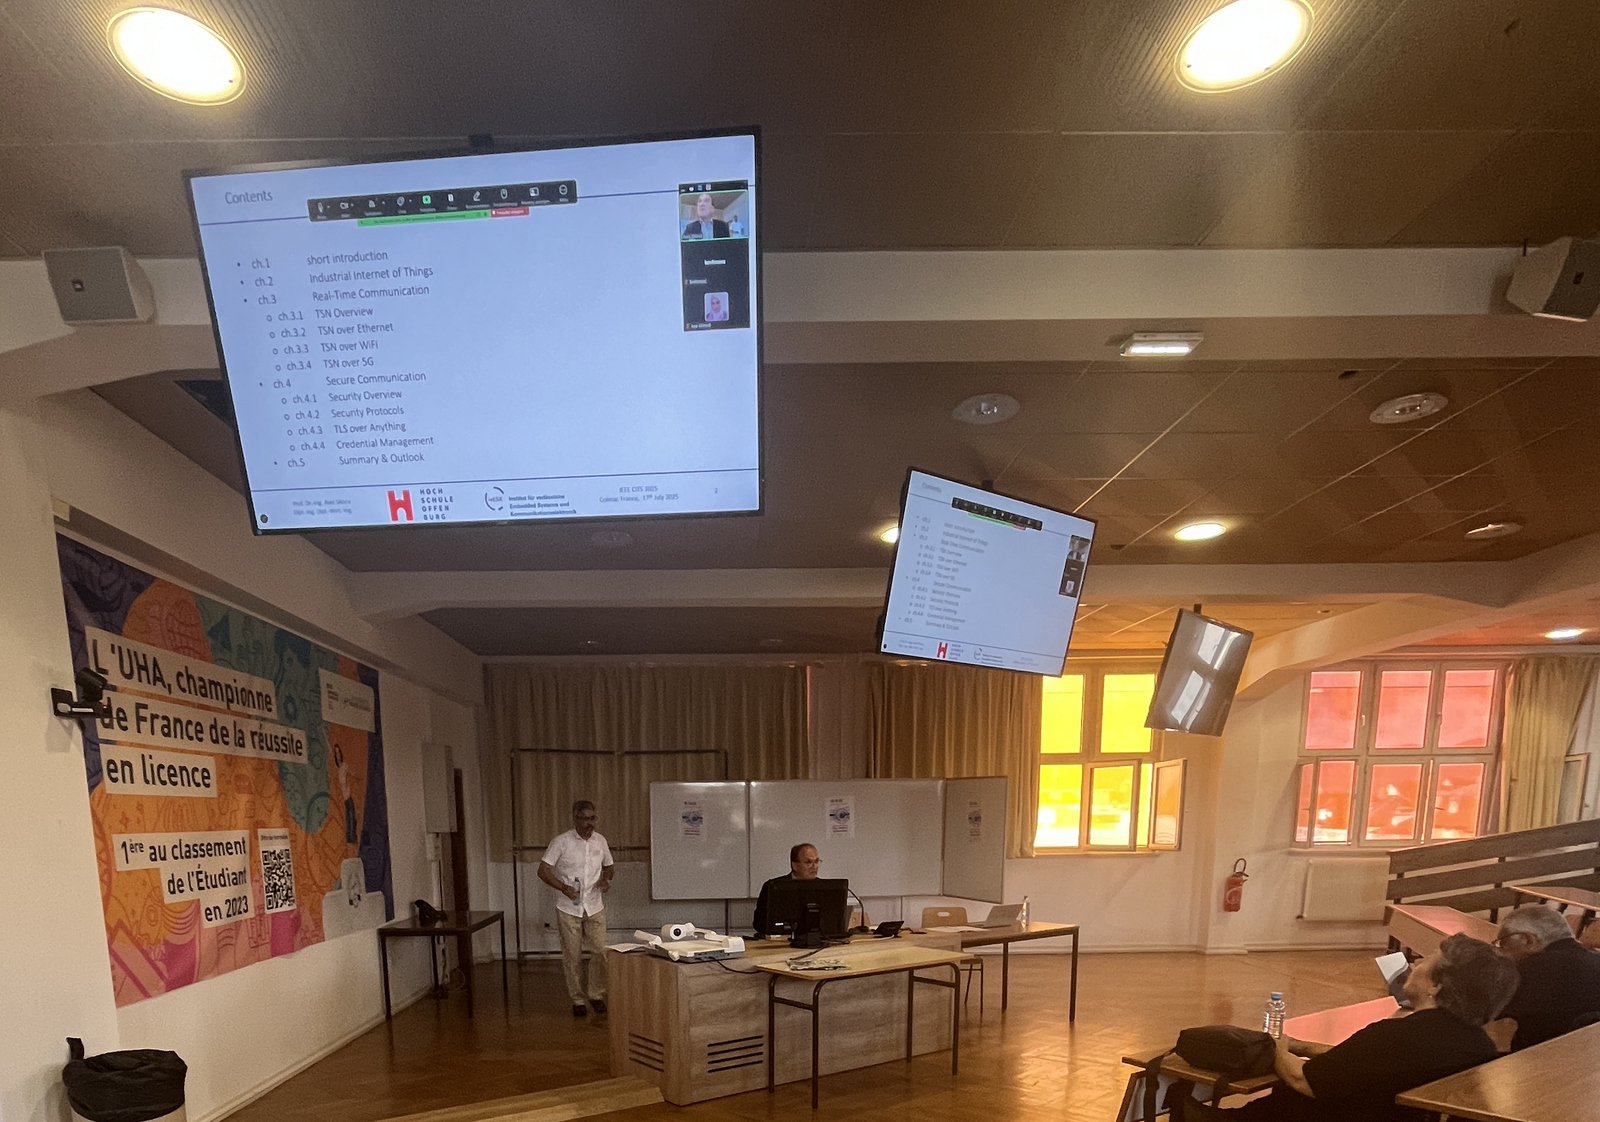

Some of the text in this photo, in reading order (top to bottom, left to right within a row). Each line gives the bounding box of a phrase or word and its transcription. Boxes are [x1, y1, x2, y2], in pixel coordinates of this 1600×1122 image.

[225, 190, 273, 204] Contents
[252, 250, 388, 269] ch.1 short introduction
[255, 266, 433, 286] ch.2 Industrial Internet of Things
[258, 285, 430, 305] ch.3 Real-Time Communication
[315, 309, 332, 318] TSN
[334, 307, 373, 318] Overview
[318, 326, 334, 335] TSN
[337, 326, 354, 334] over
[357, 322, 393, 333] Ethernet
[321, 343, 337, 352] TSN
[340, 343, 357, 351] over
[359, 340, 378, 350] WiFi
[323, 359, 340, 368] TSN
[342, 360, 359, 368] over
[362, 357, 374, 366] 5G
[326, 376, 355, 386] Secure
[358, 372, 426, 384] Communication
[329, 392, 362, 402] Security
[363, 390, 402, 400] Overview
[331, 408, 363, 418] Security
[366, 406, 404, 416] Protocols
[334, 424, 348, 433] TLS
[350, 425, 367, 433] over
[370, 422, 406, 432] Anything
[336, 439, 377, 449] Credential
[380, 437, 434, 447] Management
[339, 456, 379, 465] Summary
[381, 454, 388, 463] &
[391, 452, 425, 462] Outlook
[422, 504, 450, 512] OFFEN
[92, 639, 172, 694] L'UHA,
[176, 667, 272, 712] championne
[101, 697, 303, 757] de France de la réussite
[106, 753, 212, 788] en licence
[121, 837, 247, 864] 1ère au classement
[167, 864, 247, 895] de l'Étudiant
[204, 898, 249, 921] en 2023
